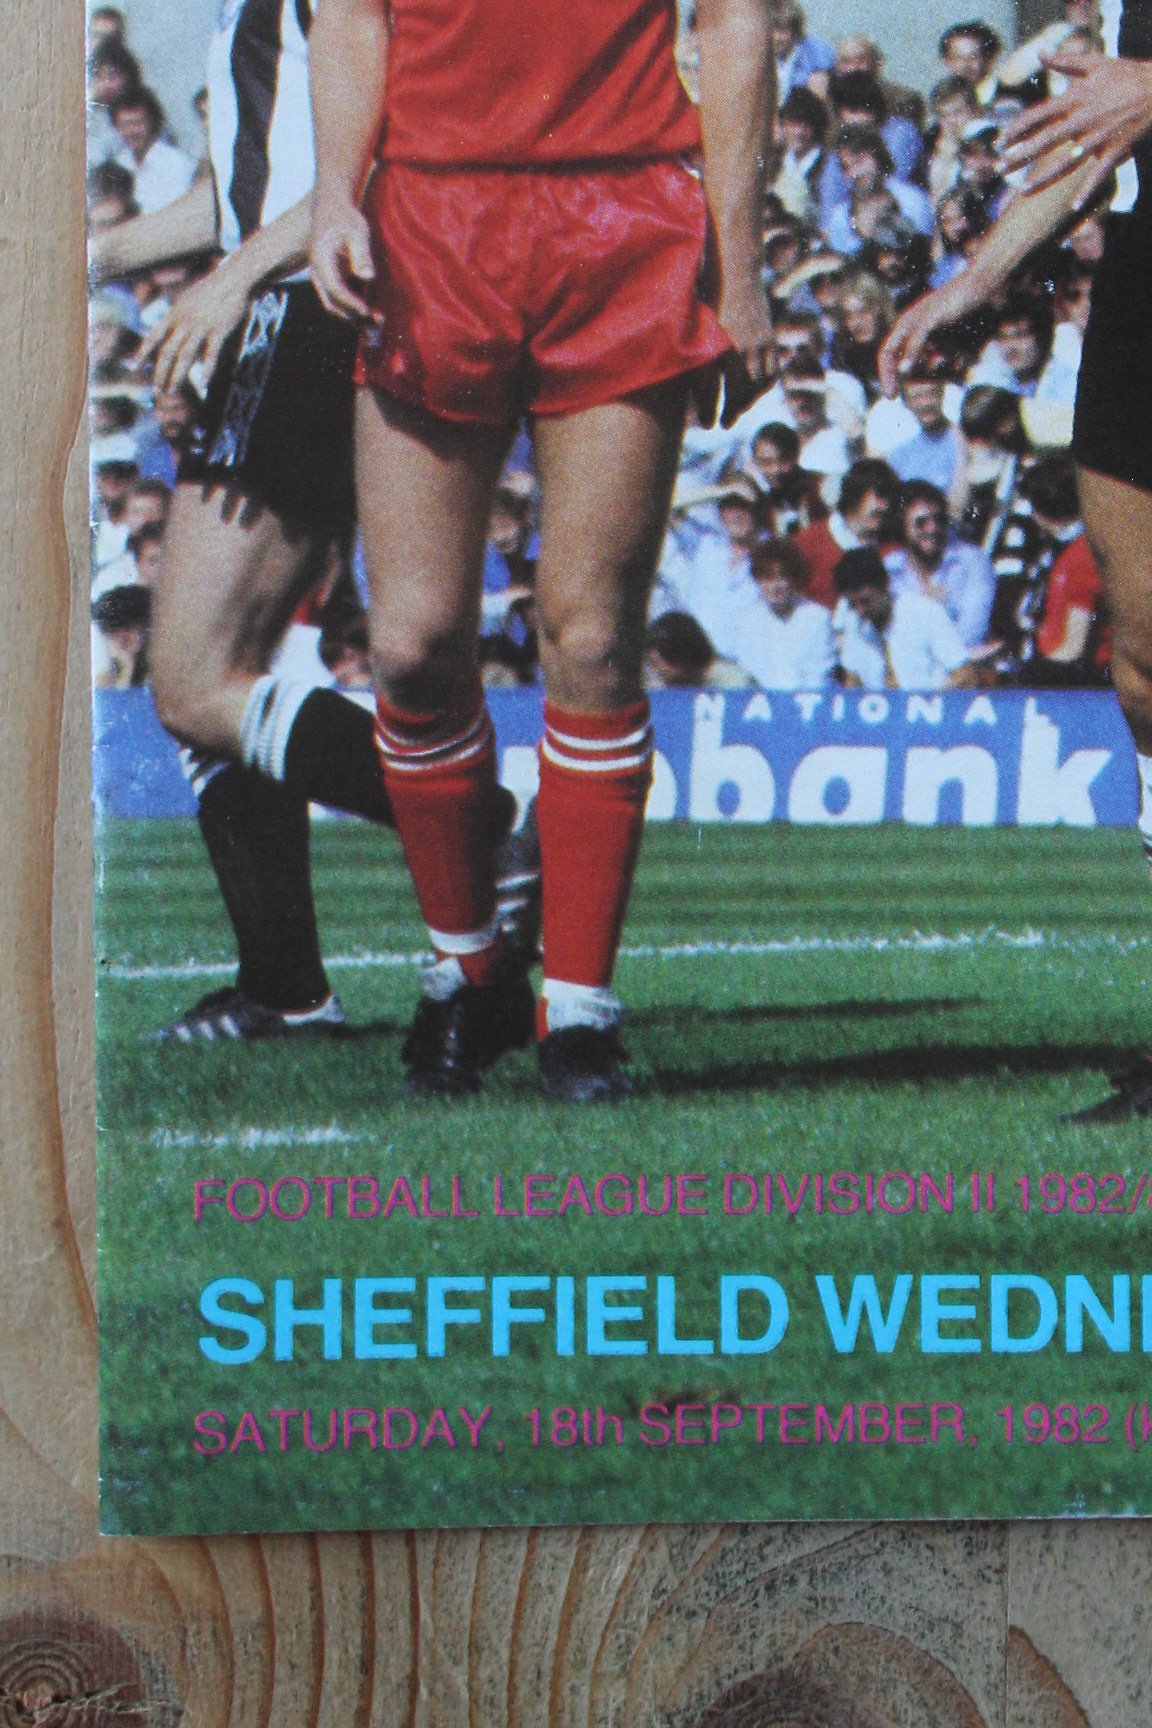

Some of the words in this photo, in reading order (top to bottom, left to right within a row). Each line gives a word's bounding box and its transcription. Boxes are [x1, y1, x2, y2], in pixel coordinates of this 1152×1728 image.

[194, 1175, 478, 1221] FOOTBALL
[494, 1173, 707, 1217] LEAGUE
[724, 1172, 954, 1216] DIVISION
[972, 1172, 995, 1213] II
[199, 1274, 789, 1364] SHEFFIELD
[526, 1405, 624, 1447] 18th
[640, 1402, 978, 1449] SEPTEMBER,
[1000, 1403, 1111, 1444] 1982
